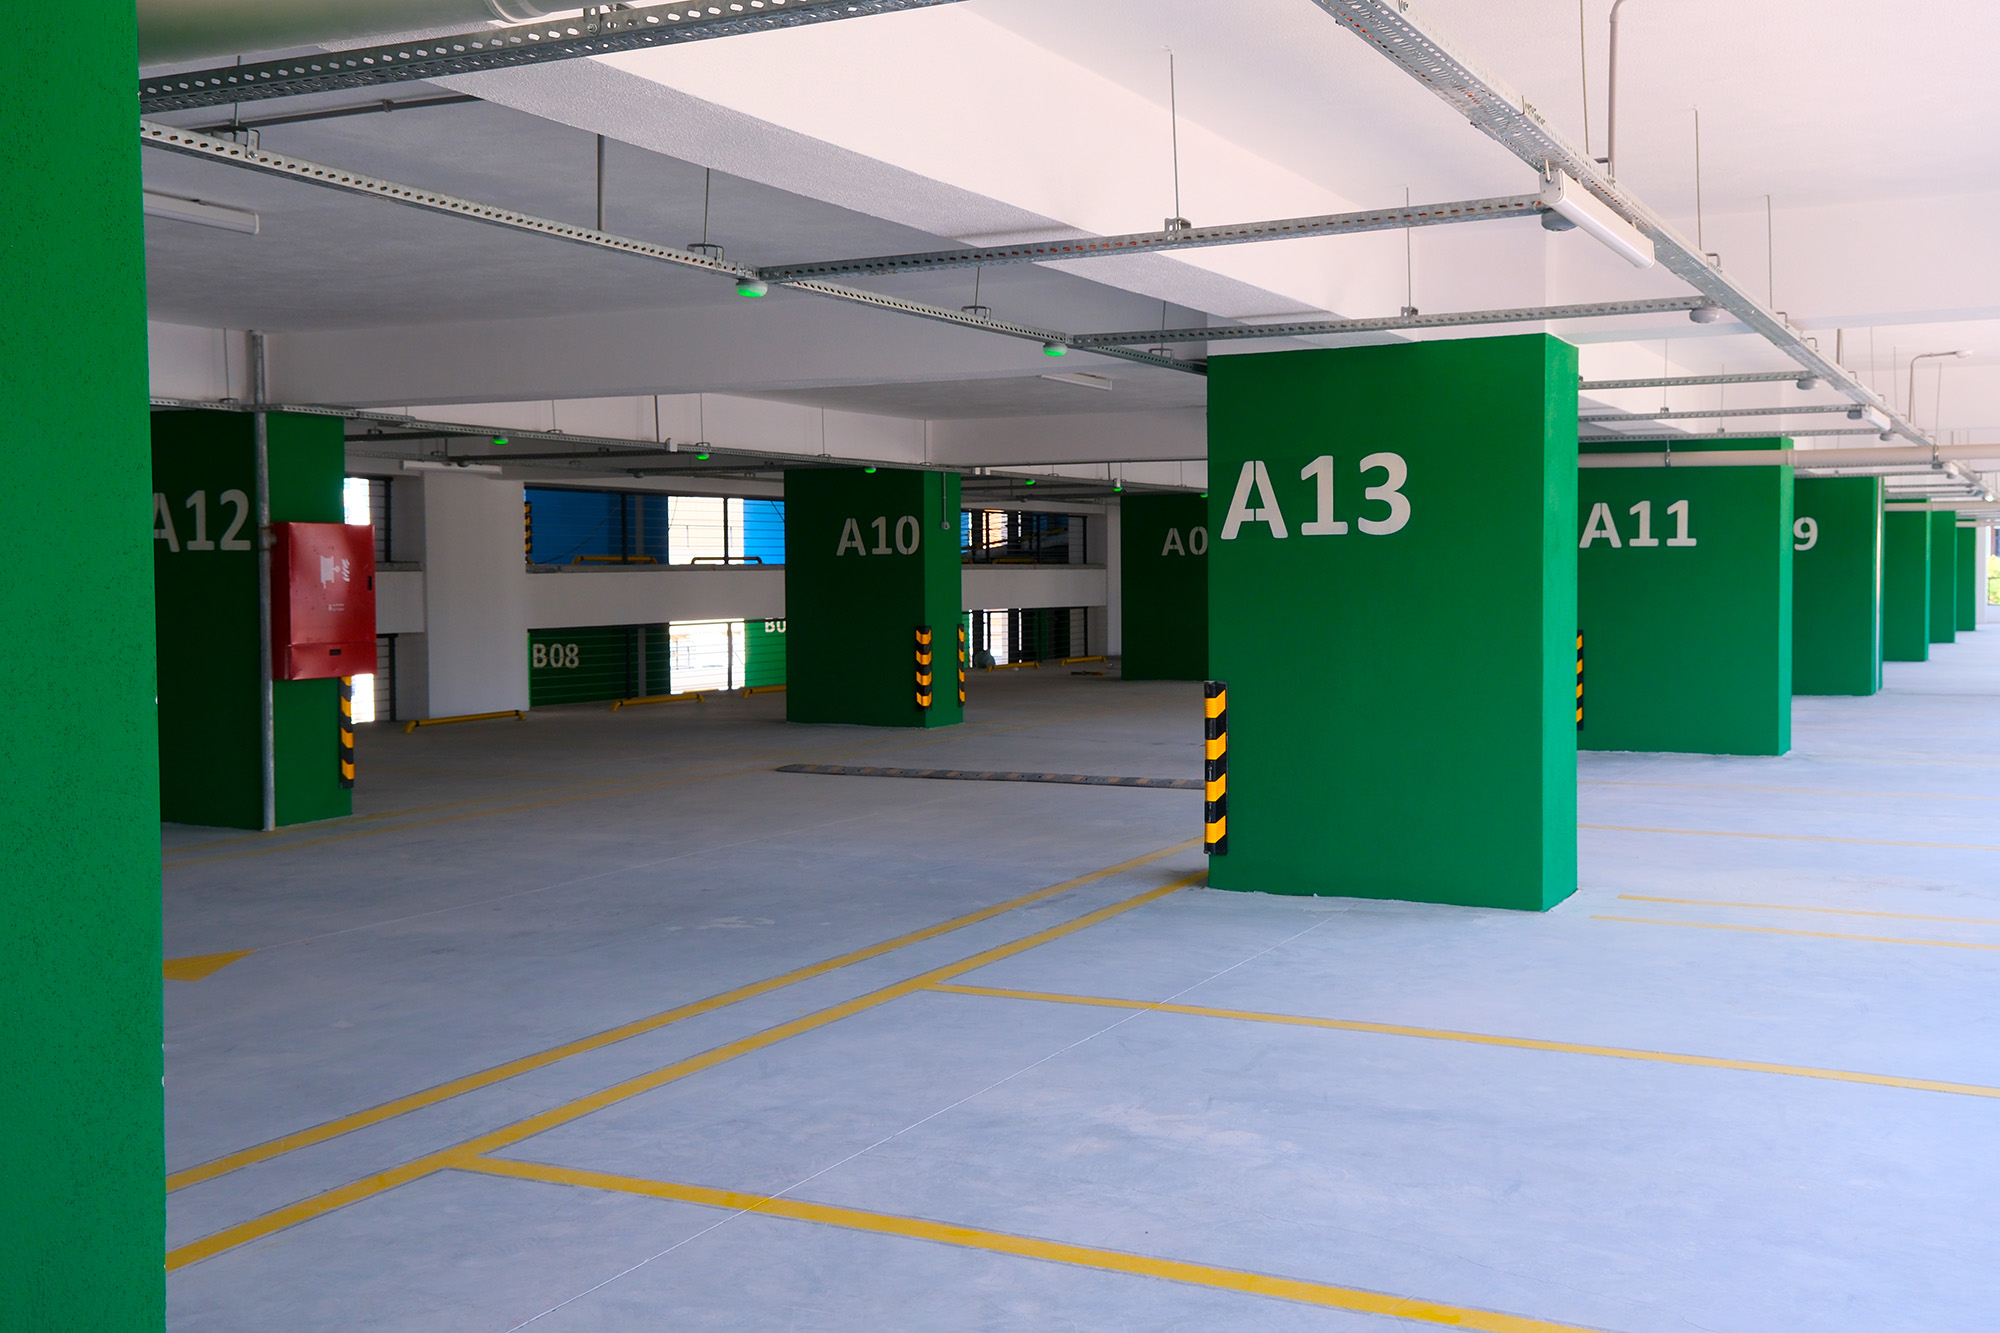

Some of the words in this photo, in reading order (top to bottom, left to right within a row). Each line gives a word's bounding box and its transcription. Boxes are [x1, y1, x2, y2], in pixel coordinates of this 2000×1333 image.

[1220, 452, 1411, 540] A13
[153, 489, 251, 552] A12
[836, 515, 920, 556] A10
[1579, 500, 1697, 548] A11
[533, 643, 579, 669] B08
